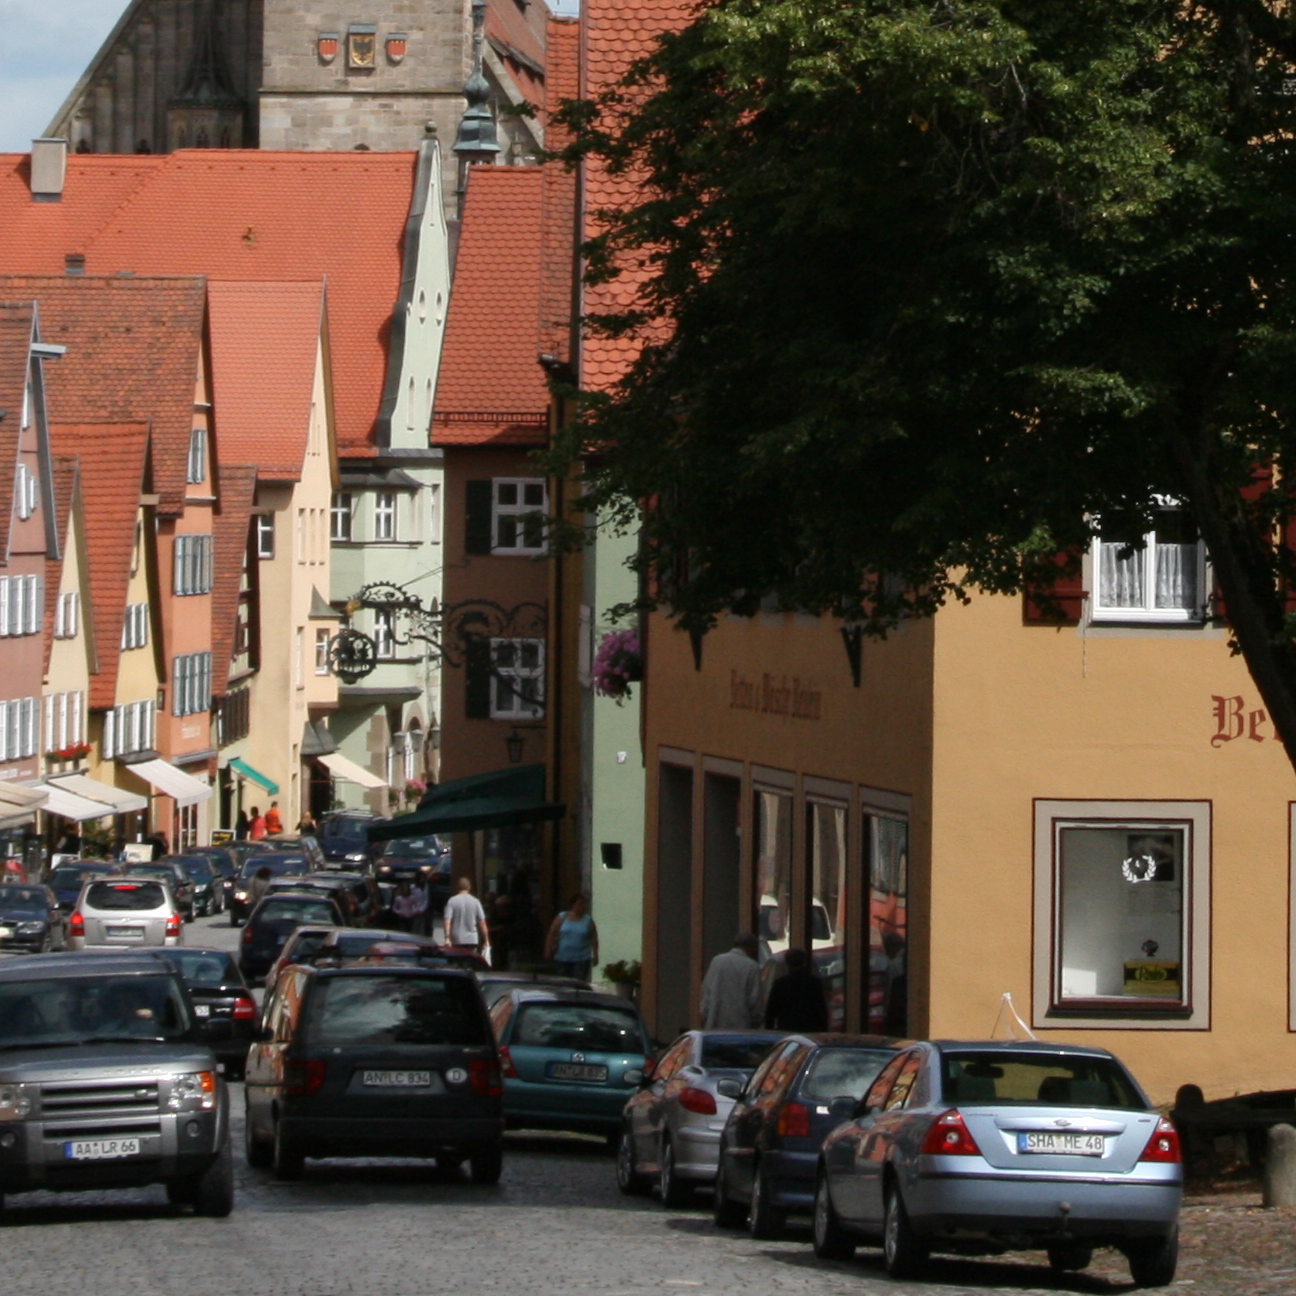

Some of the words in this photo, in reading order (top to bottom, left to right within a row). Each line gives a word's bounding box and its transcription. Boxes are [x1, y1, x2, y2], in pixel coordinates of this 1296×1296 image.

[365, 1072, 383, 1084] AN
[452, 1069, 461, 1082] D
[76, 1143, 92, 1156] AA
[101, 1141, 118, 1154] LR
[121, 1140, 136, 1153] 66
[1027, 1134, 1055, 1149] SHA
[1064, 1135, 1083, 1150] ME
[1085, 1135, 1103, 1151] 48
